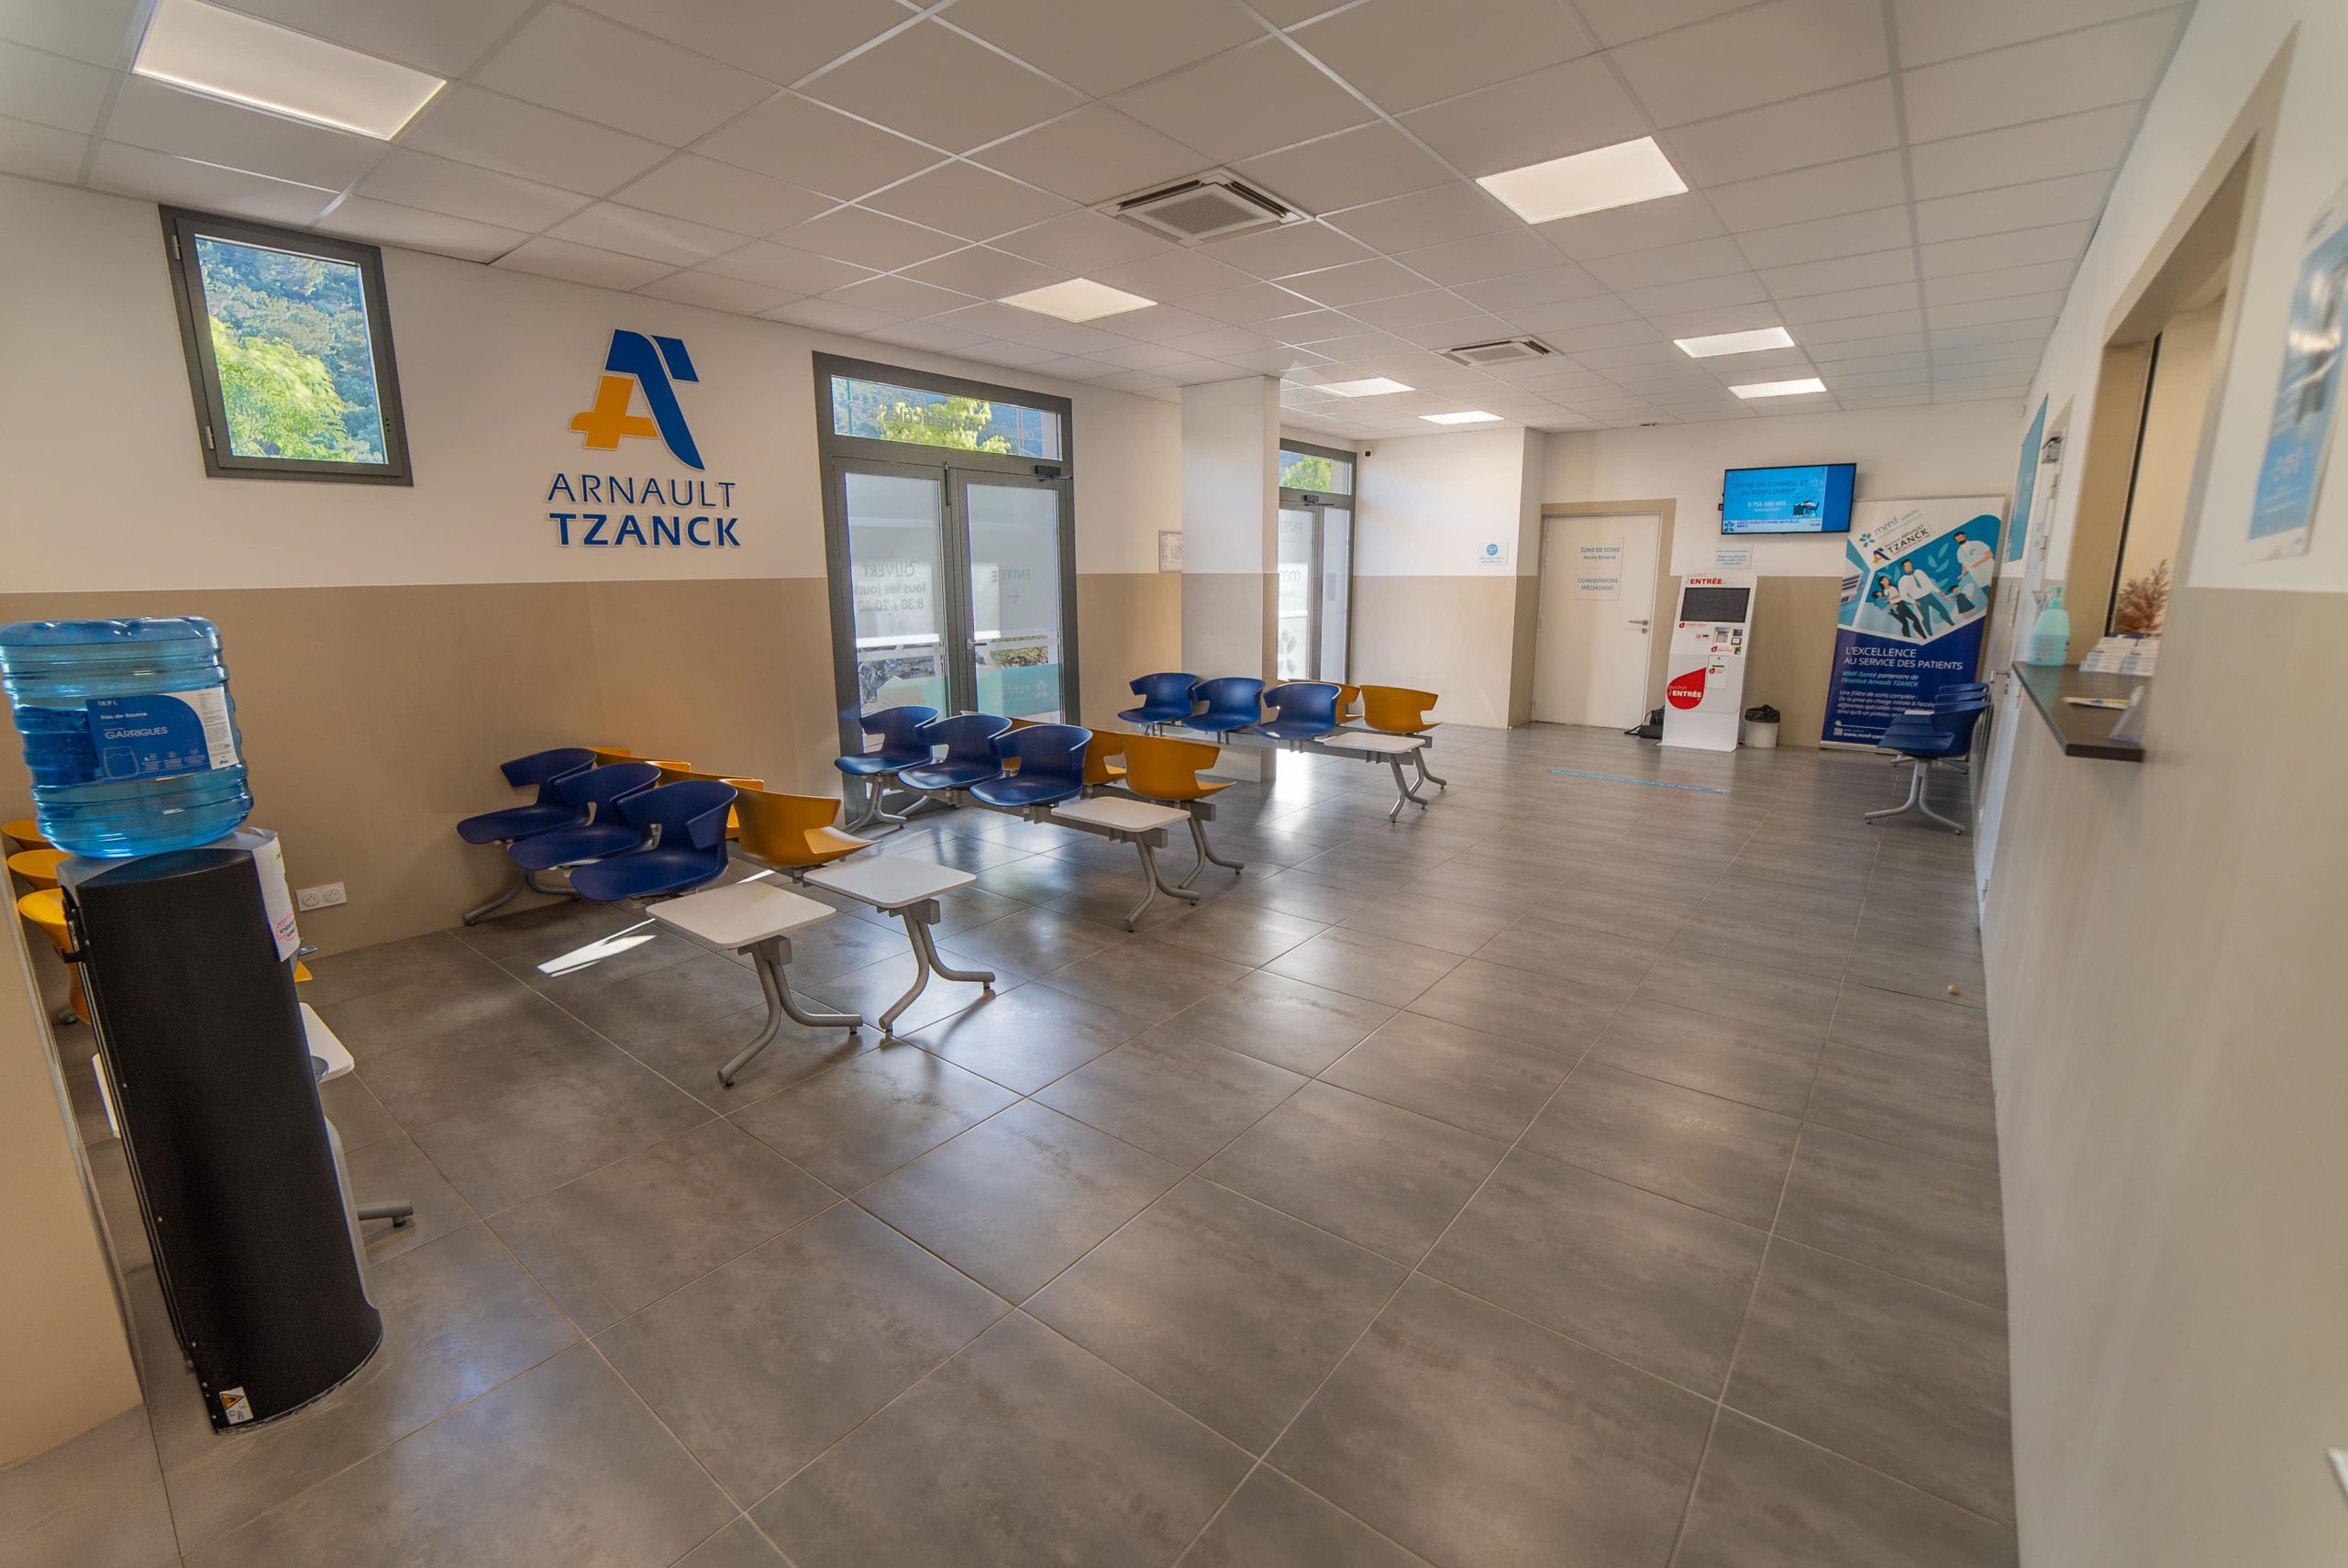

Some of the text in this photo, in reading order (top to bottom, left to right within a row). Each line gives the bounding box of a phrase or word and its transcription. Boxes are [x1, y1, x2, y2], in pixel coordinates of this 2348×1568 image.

[546, 472, 737, 509] ARNAULT
[547, 513, 741, 547] TZANCK
[1887, 528, 1930, 554] TZANCK
[1845, 646, 1917, 657] L'EXCELLENCE
[1858, 657, 1896, 668] SERVICE
[1897, 659, 1916, 668] DES
[1917, 660, 1964, 670] PATIENTS
[105, 726, 169, 740] GARRIGUES
